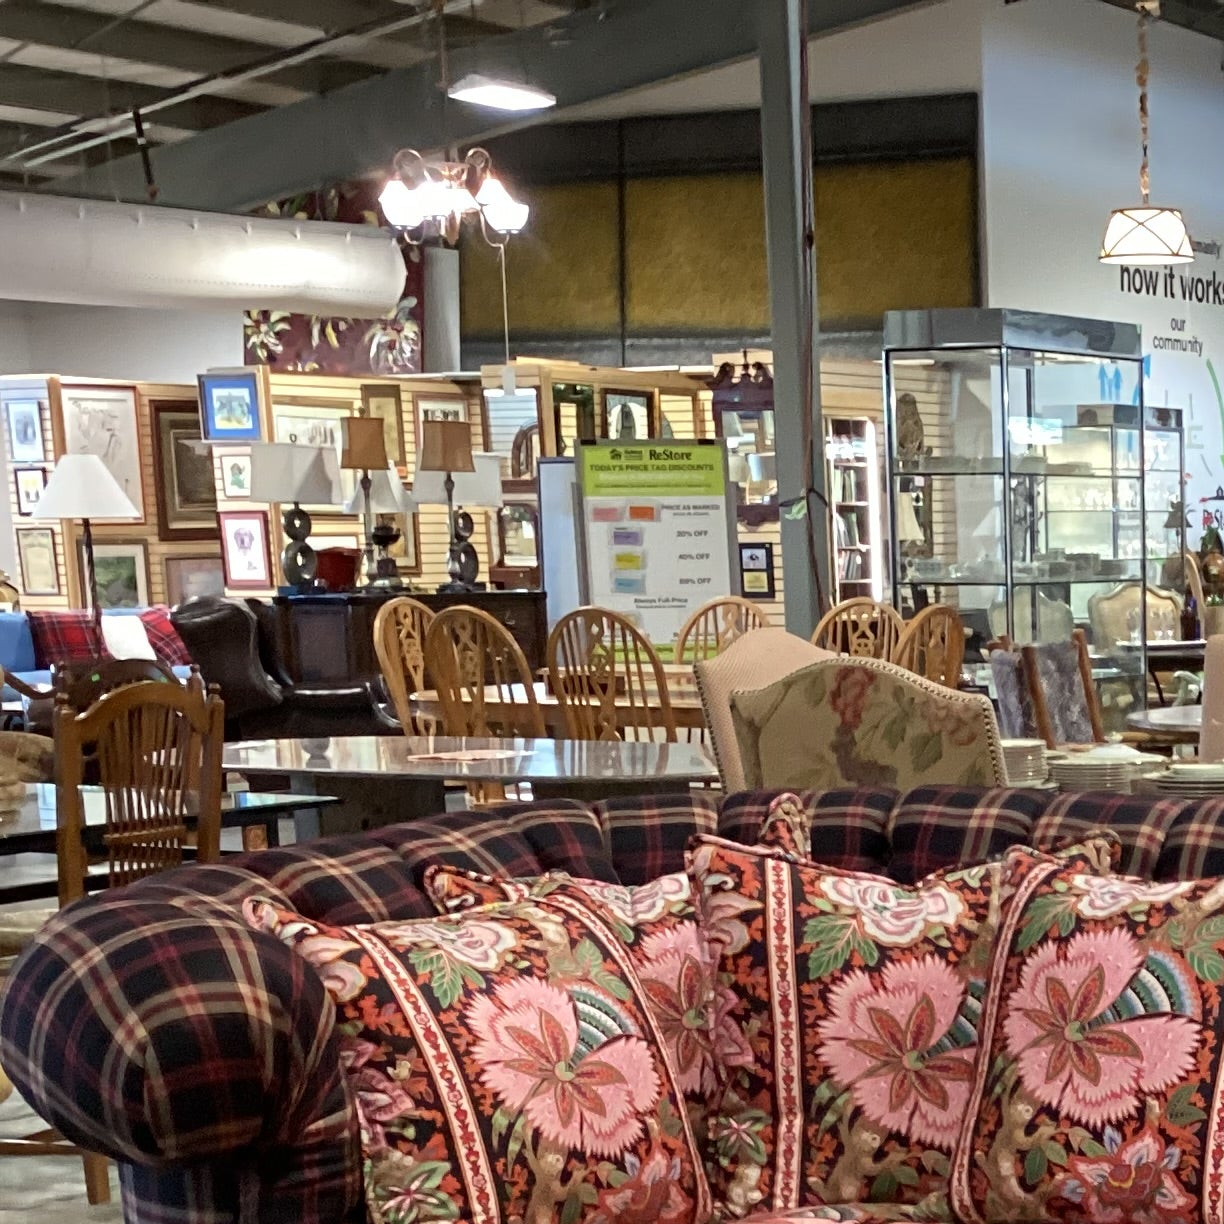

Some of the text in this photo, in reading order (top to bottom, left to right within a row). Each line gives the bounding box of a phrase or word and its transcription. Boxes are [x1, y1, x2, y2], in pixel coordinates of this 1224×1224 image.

[1164, 264, 1175, 299] it
[1170, 317, 1186, 332] our
[1152, 335, 1204, 357] community
[649, 448, 692, 461] ReStore
[693, 529, 709, 537] OFF
[695, 552, 711, 561] OFF
[696, 577, 712, 585] OFF
